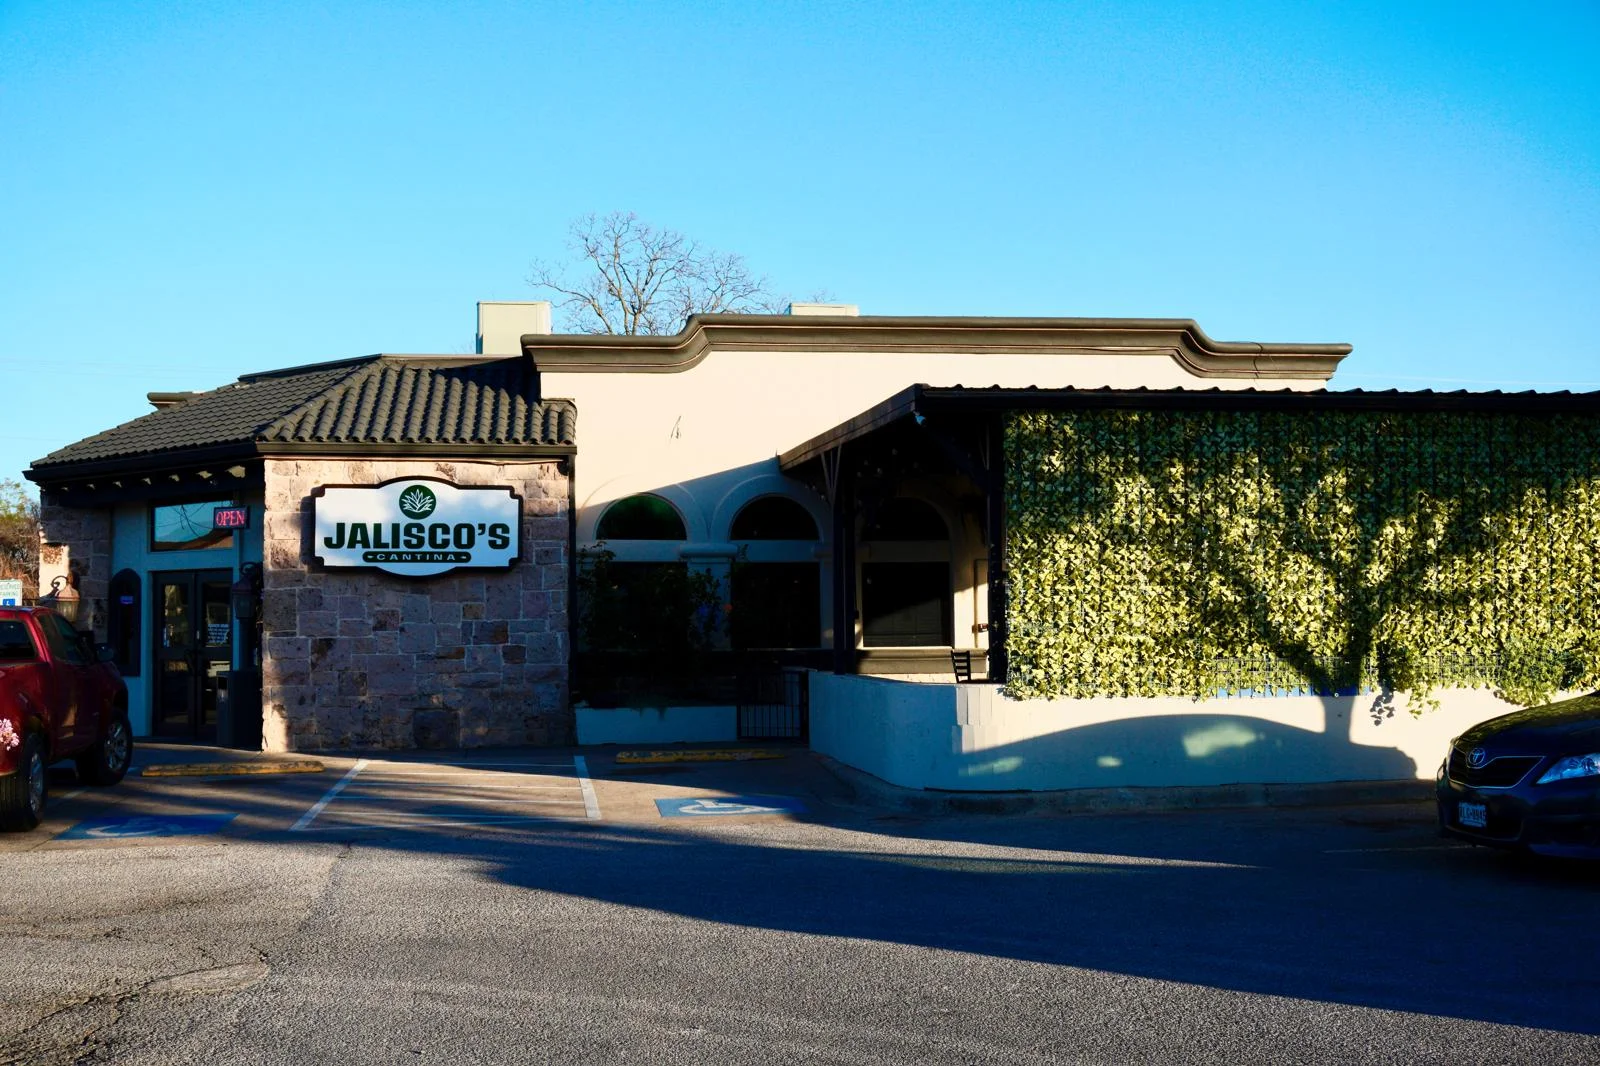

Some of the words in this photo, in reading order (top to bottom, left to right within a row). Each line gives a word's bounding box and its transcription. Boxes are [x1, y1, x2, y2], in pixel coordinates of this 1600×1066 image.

[216, 510, 245, 526] OPEN
[324, 522, 510, 550] JALISCO'S
[376, 552, 456, 561] CANTINA
